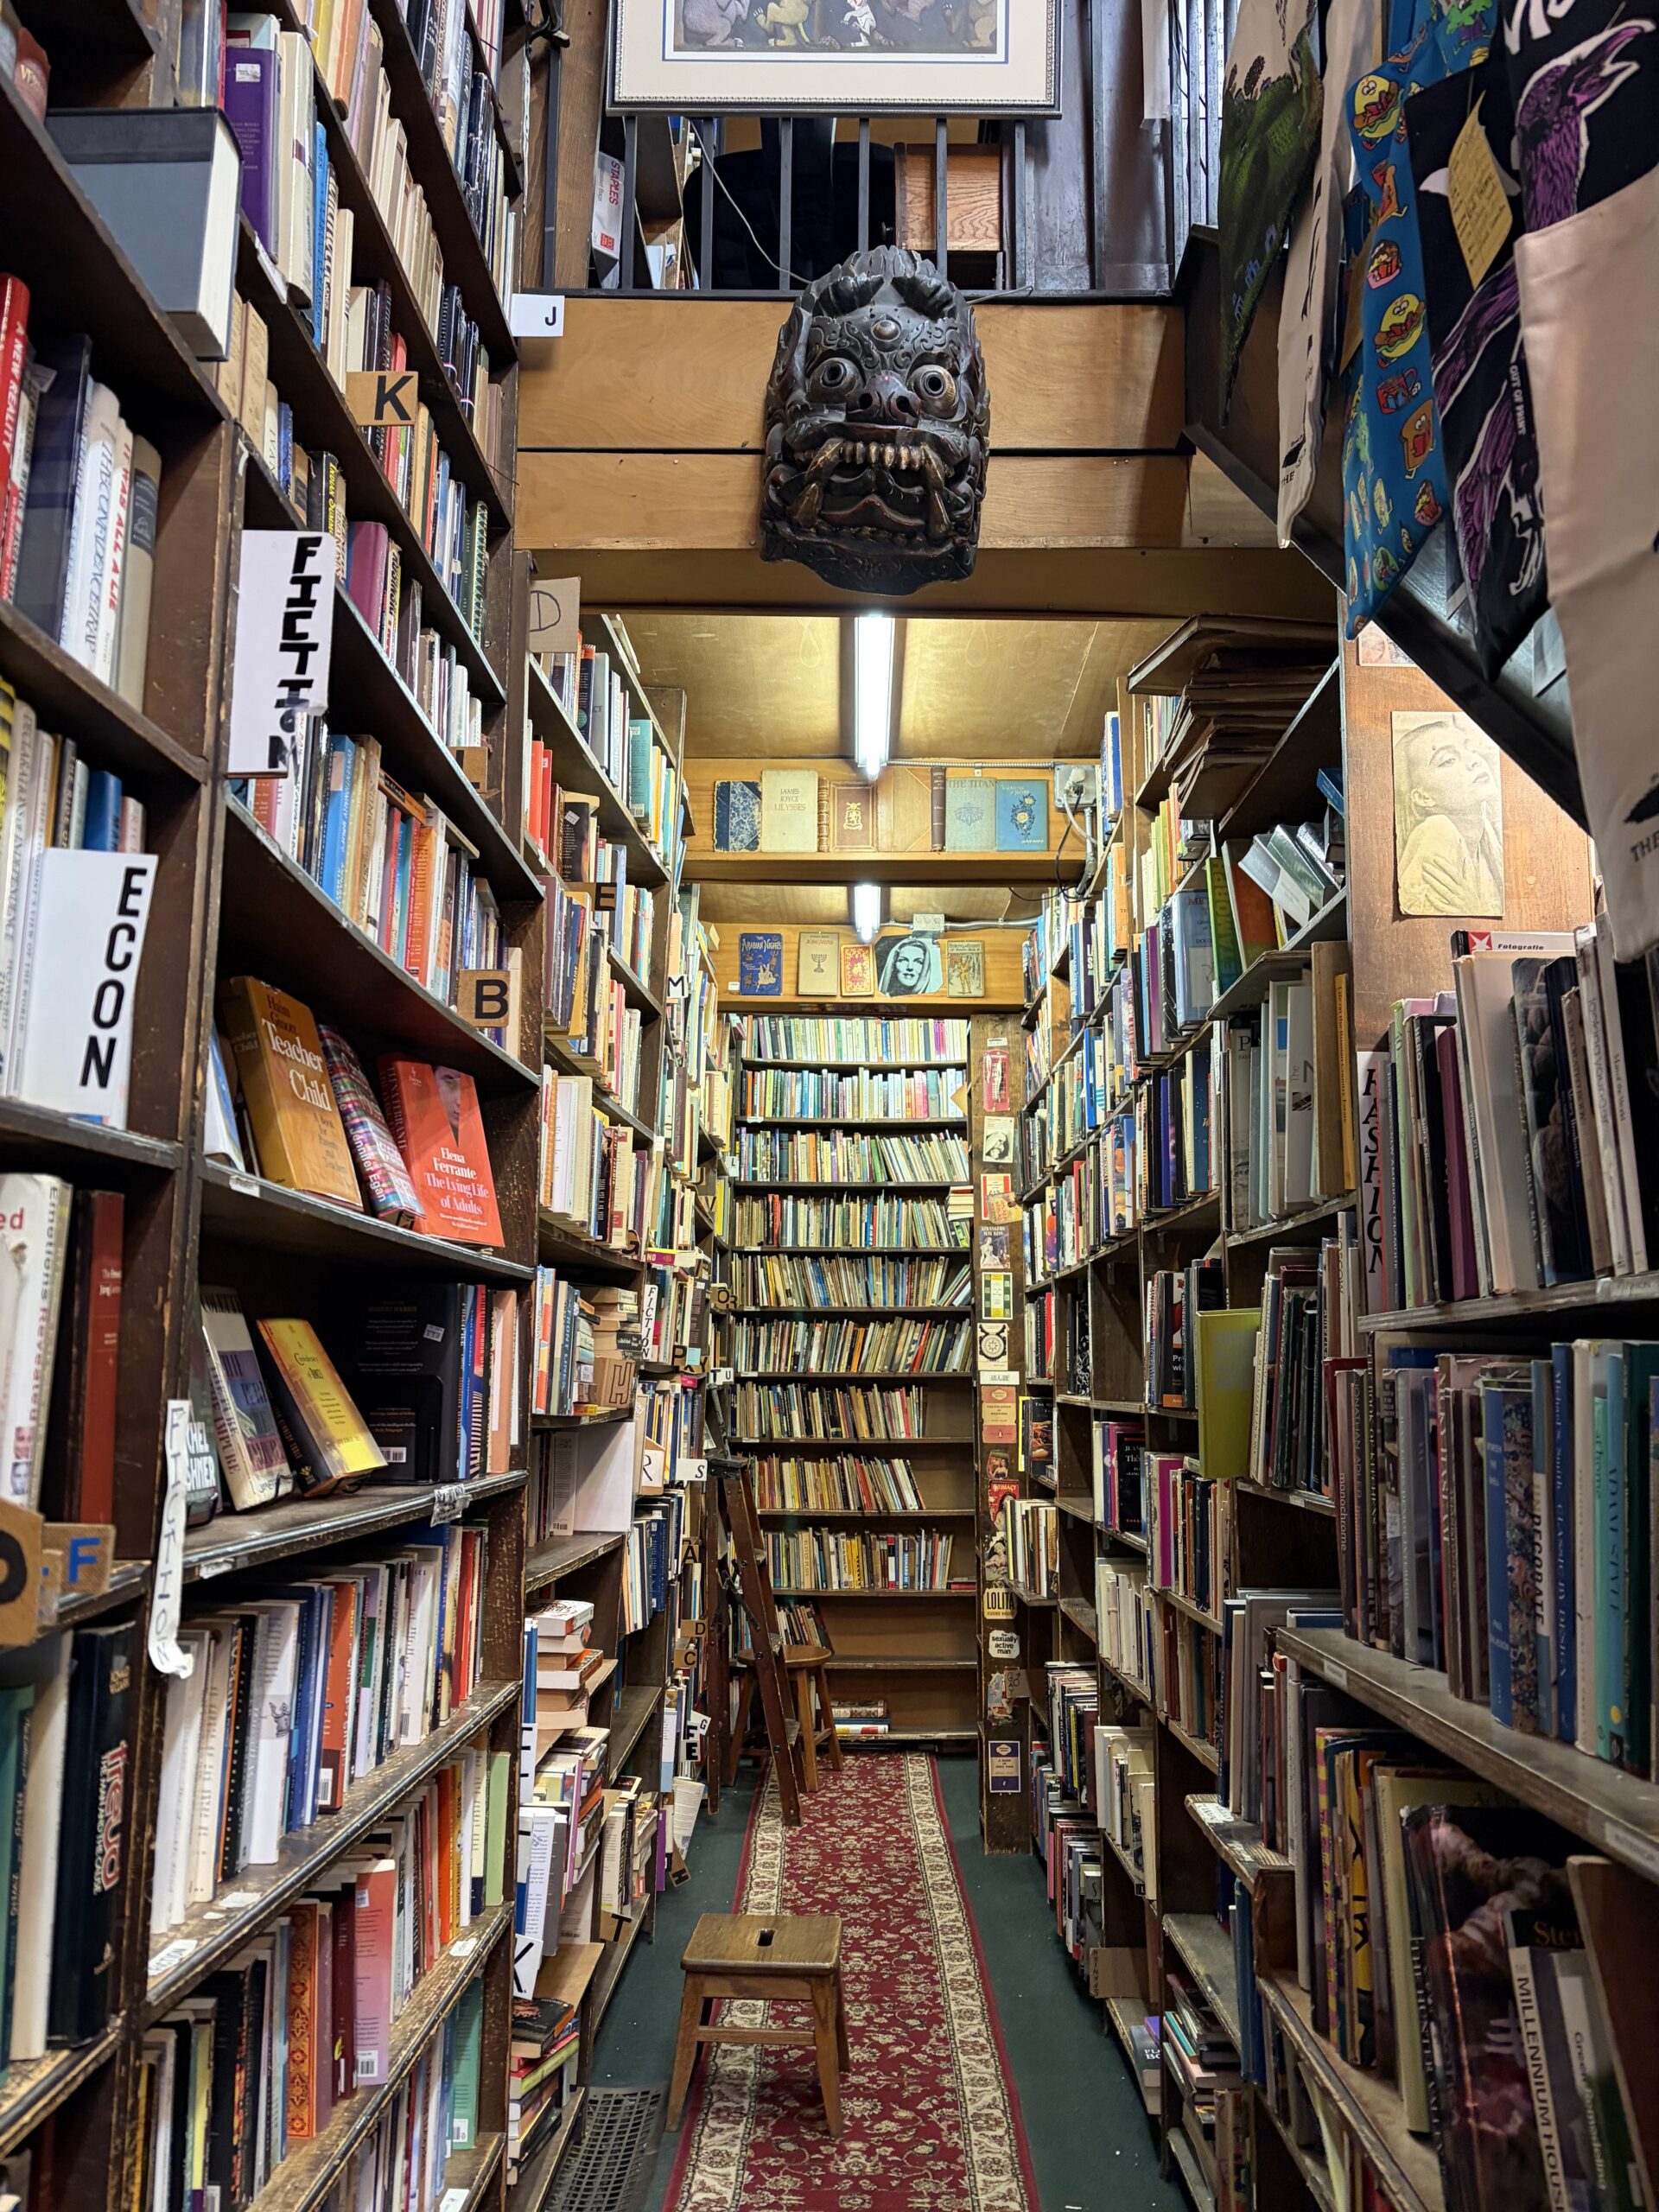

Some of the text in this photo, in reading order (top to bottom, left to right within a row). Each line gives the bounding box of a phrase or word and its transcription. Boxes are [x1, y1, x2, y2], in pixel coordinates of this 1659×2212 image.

[609, 161, 620, 206] STAPLES
[544, 306, 556, 326] J
[2, 321, 24, 455] A NEW REALITY
[1510, 365, 1519, 389] OUT
[373, 375, 414, 421] K
[118, 468, 130, 508] WAS
[328, 462, 338, 497] INDIAN
[112, 516, 125, 553] ALL
[111, 559, 120, 574] A
[109, 579, 118, 613] LIE
[269, 537, 323, 769] FICTION
[947, 779, 995, 789] THE TITAN
[594, 882, 618, 912] E
[1497, 943, 1545, 951] Fotografie
[79, 866, 148, 1090] ECON
[668, 976, 687, 997] M
[474, 979, 509, 1020] B
[262, 1018, 323, 1073] Teacher
[1414, 1027, 1423, 1062] HERO
[289, 1068, 333, 1112] Child
[349, 1126, 385, 1203] Jennifer Egan
[433, 1157, 477, 1180] Ferrante
[440, 1147, 466, 1164] Elena
[424, 1172, 490, 1199] The Lying Life
[441, 1194, 483, 1215] of Adults
[29, 1185, 60, 1422] Emotions Revealed
[641, 1287, 658, 1357] FICTION
[608, 1362, 635, 1405] H
[1353, 1383, 1363, 1448] JONATHAN
[695, 1465, 706, 1479] S
[1338, 1471, 1347, 1552] monochrome
[68, 1537, 101, 1585] F
[987, 1592, 1014, 1610] LOLITA
[695, 1622, 706, 1635] D
[991, 1636, 1017, 1645] sexually
[683, 1651, 696, 1666] C
[699, 1719, 708, 1730] G
[685, 1742, 699, 1761] E
[671, 1867, 690, 1886] H
[1516, 1976, 1553, 2127] MILLENNIUM
[1574, 2031, 1592, 2084] Green
